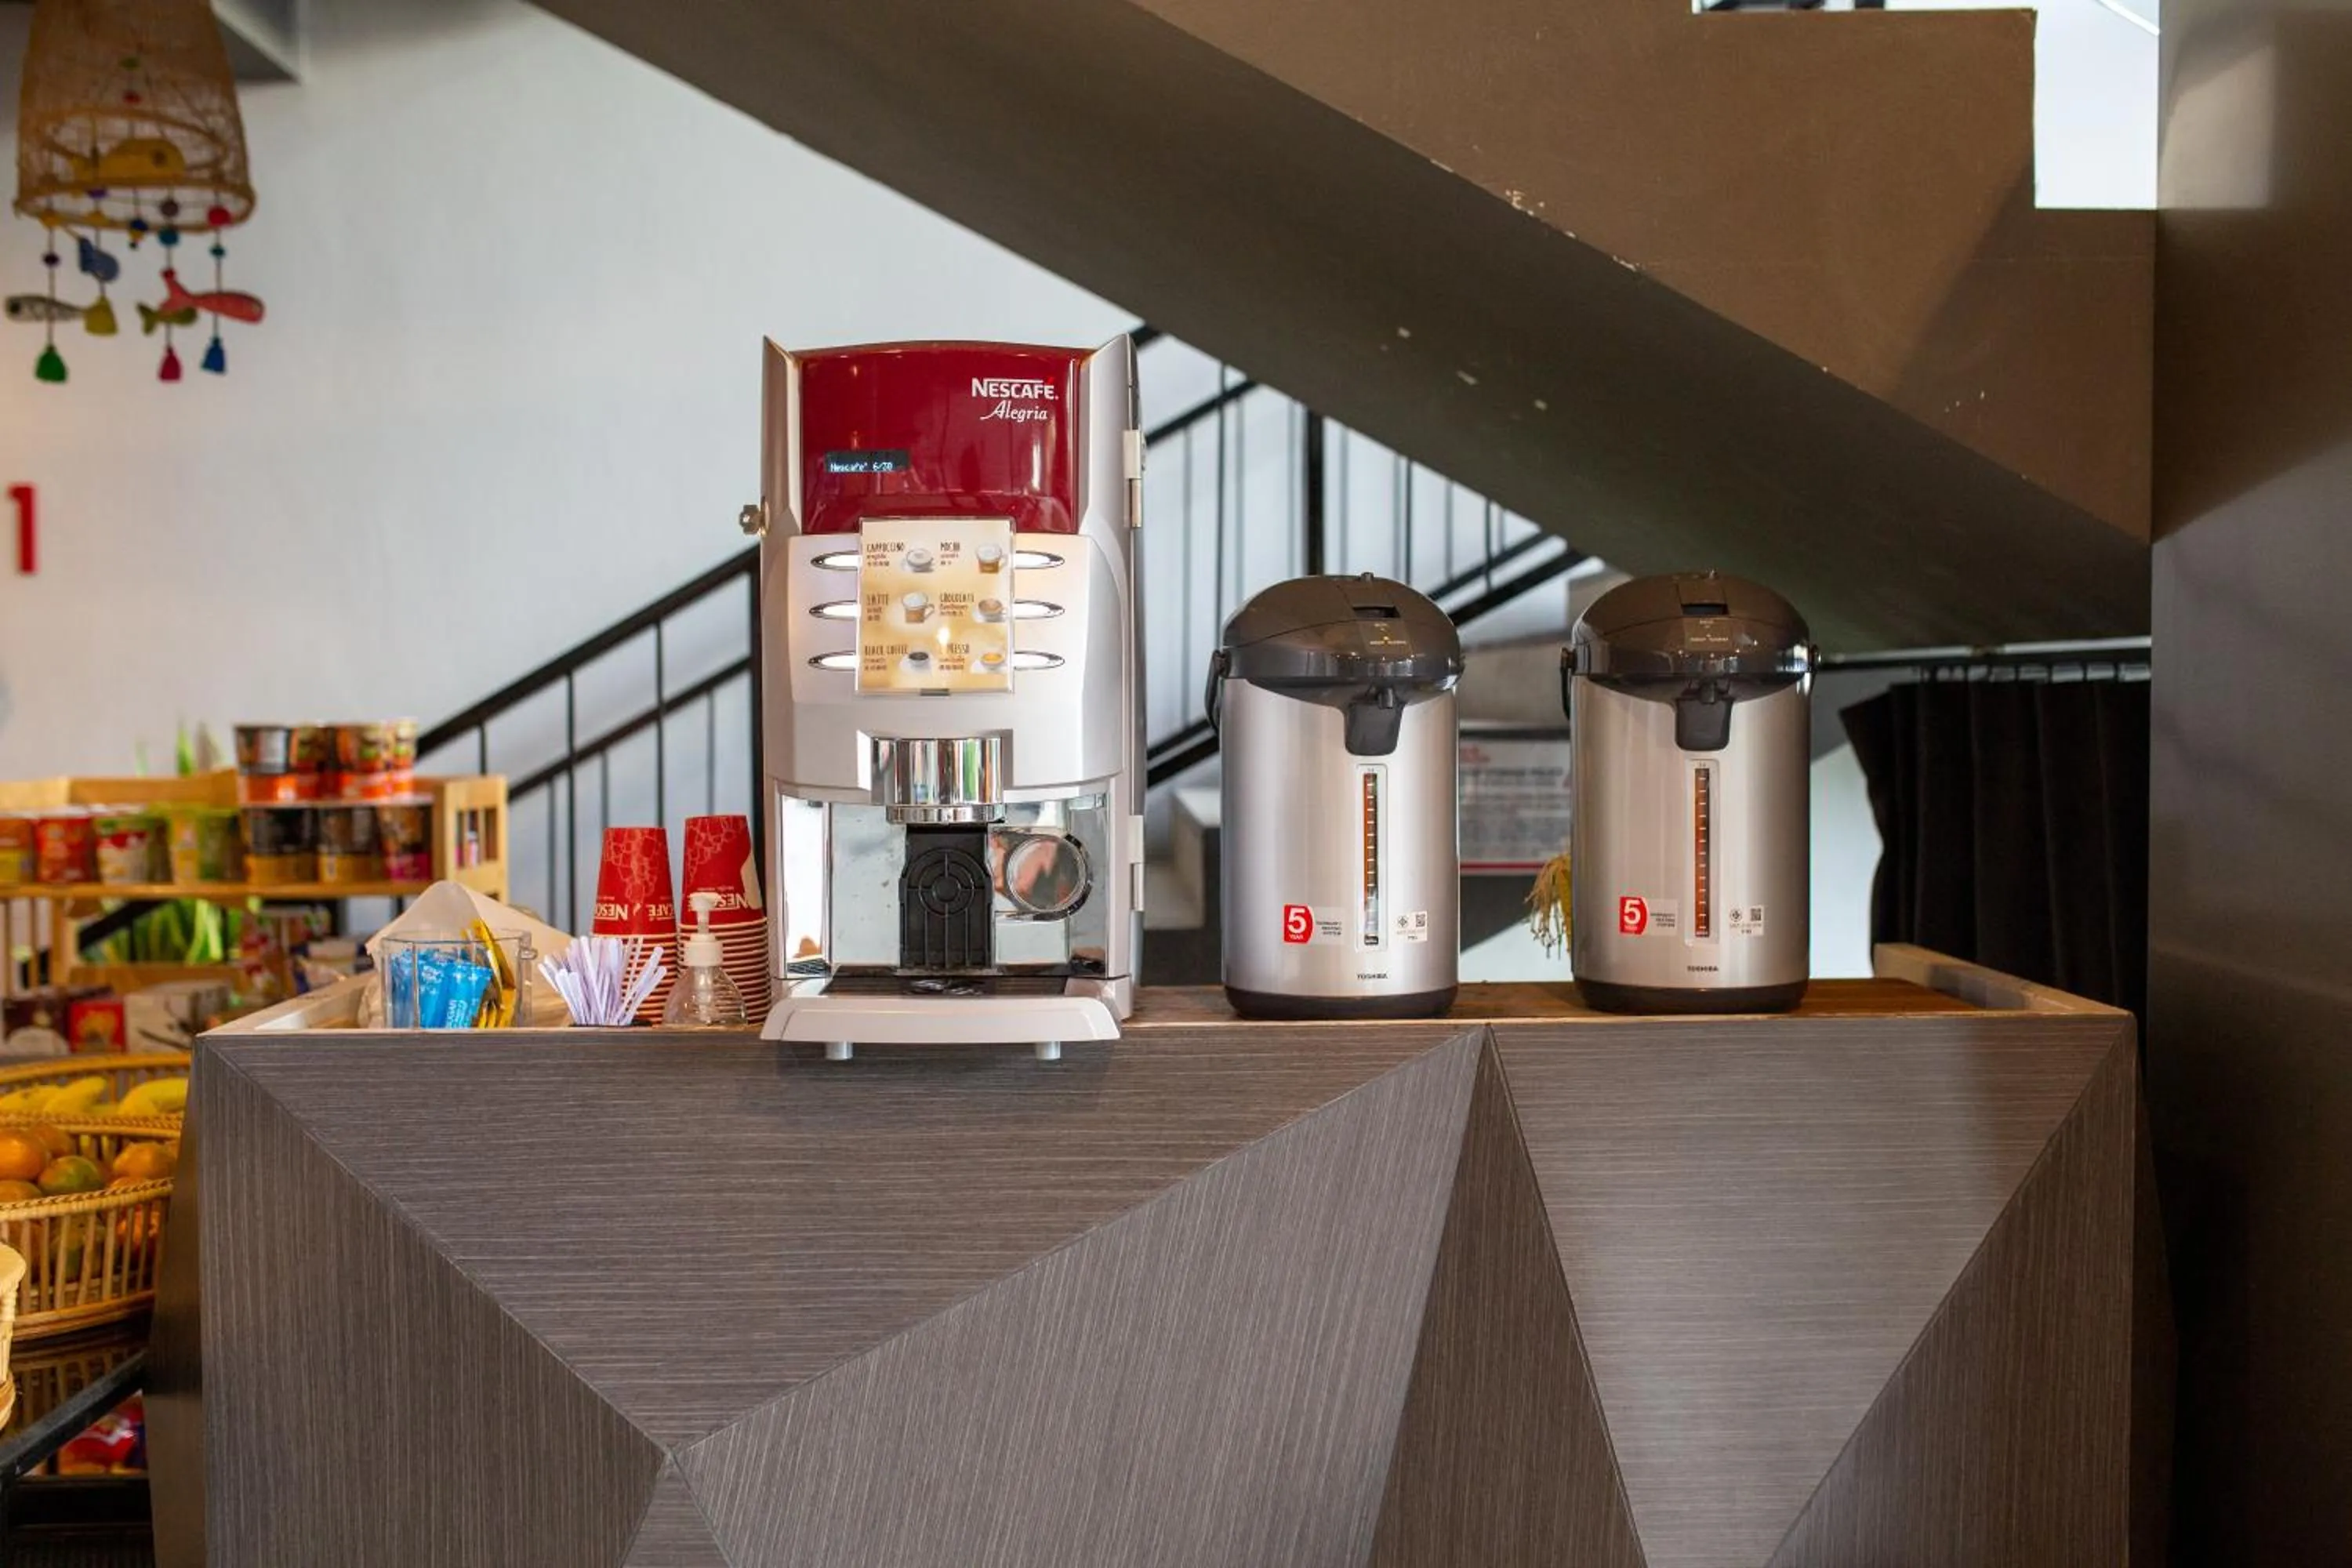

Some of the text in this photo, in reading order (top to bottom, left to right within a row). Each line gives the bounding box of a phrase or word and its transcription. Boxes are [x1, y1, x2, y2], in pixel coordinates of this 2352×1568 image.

[979, 399, 1048, 423] Alegria
[1287, 907, 1307, 935] 5
[1624, 899, 1641, 924] 5
